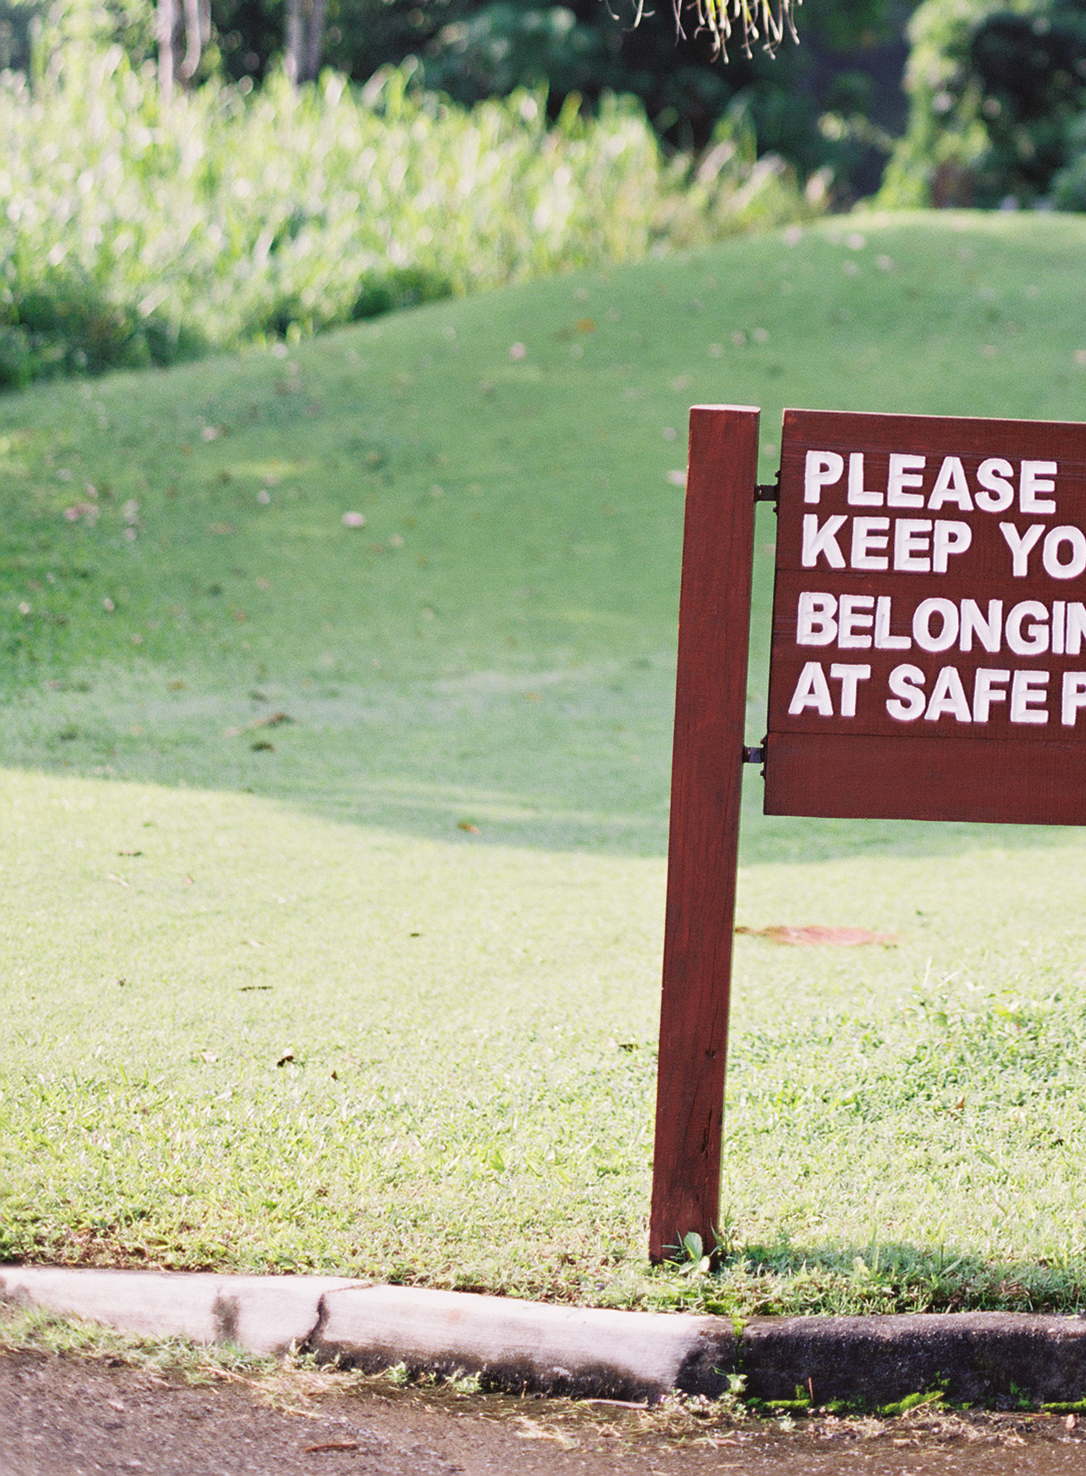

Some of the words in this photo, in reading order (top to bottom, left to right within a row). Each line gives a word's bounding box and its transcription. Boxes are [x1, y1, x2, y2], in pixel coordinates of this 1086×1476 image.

[804, 450, 1058, 514] PLEASE
[801, 513, 972, 573] KEEP
[788, 661, 872, 717] AT
[885, 663, 1050, 724] SAFE
